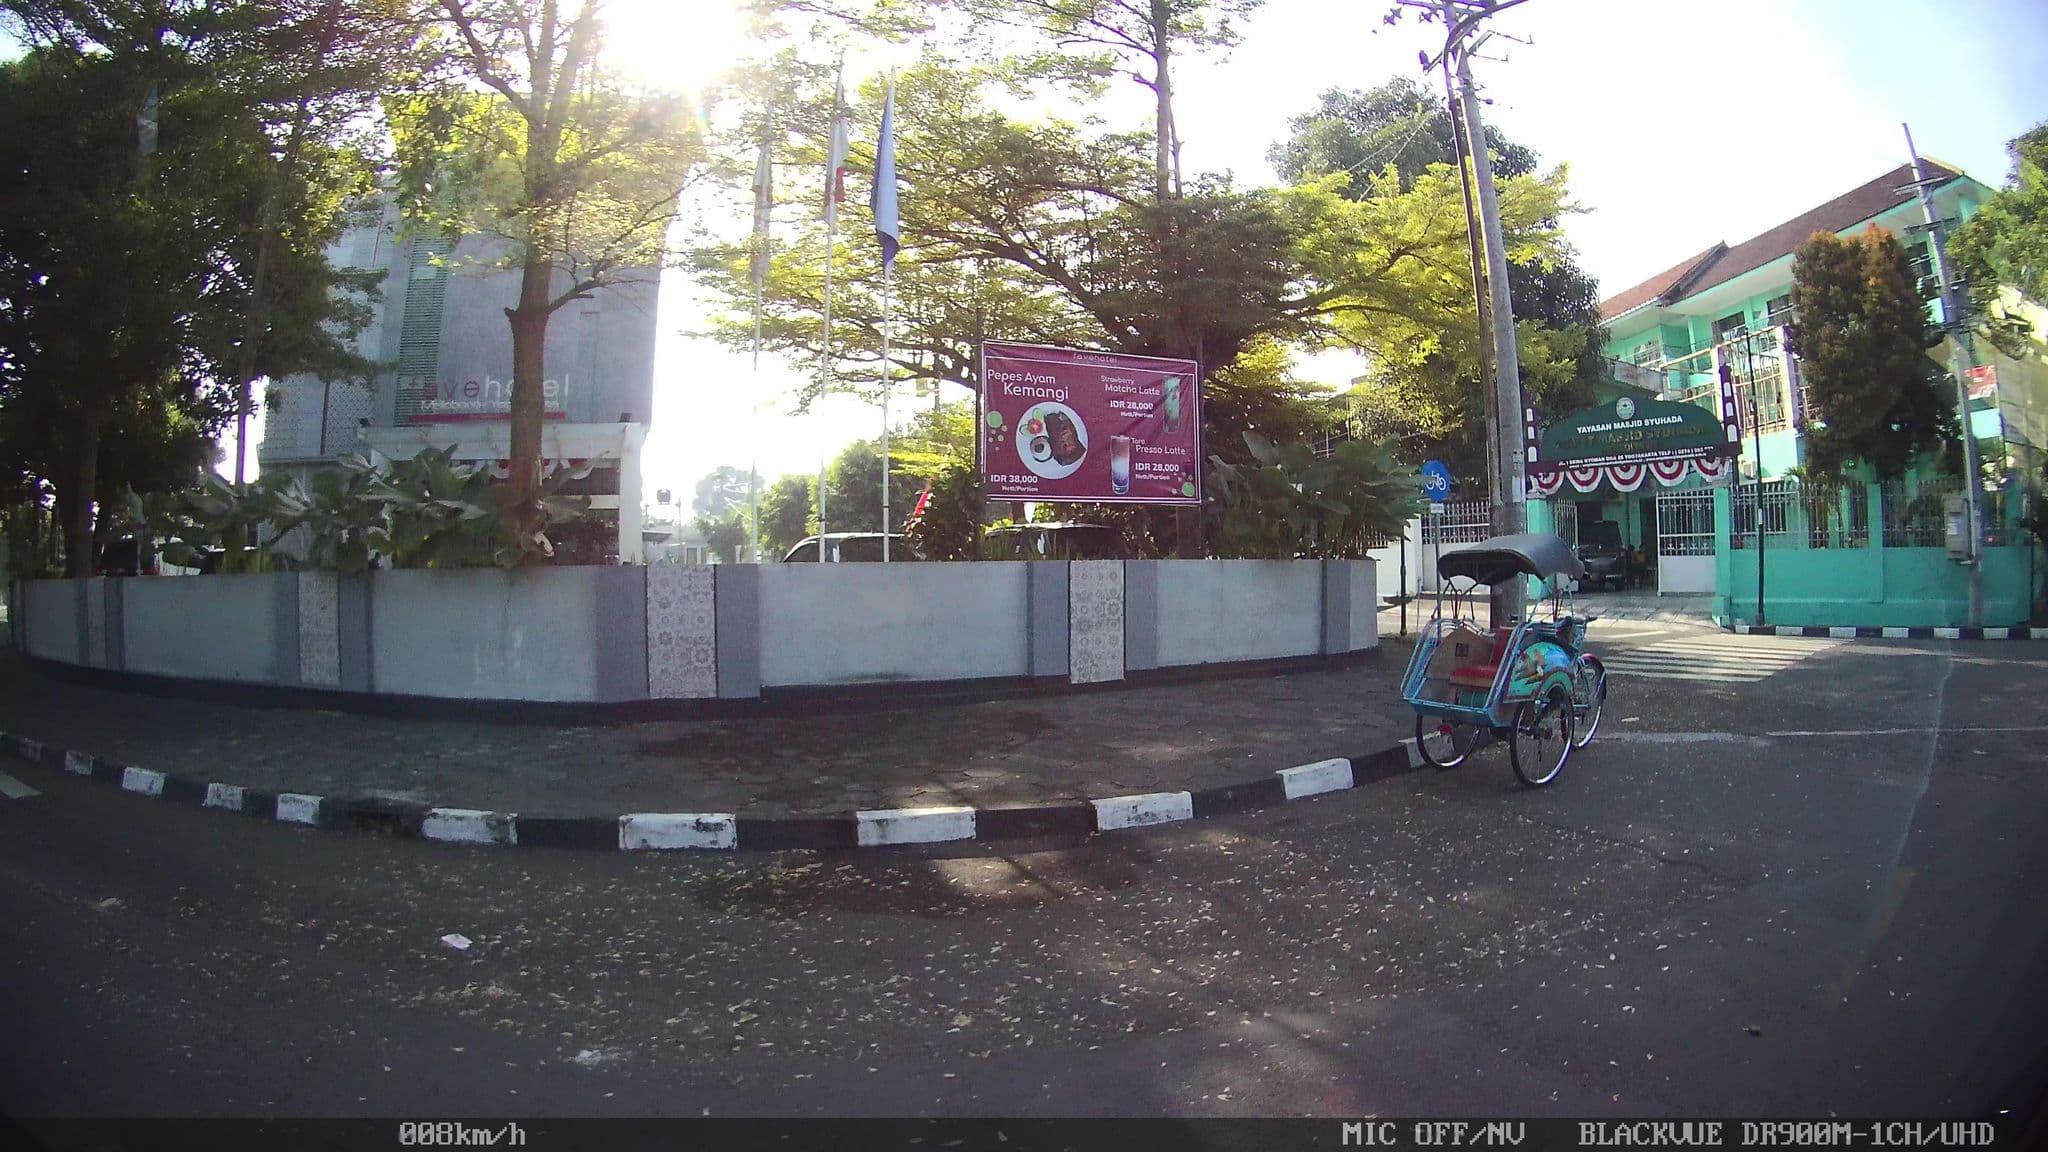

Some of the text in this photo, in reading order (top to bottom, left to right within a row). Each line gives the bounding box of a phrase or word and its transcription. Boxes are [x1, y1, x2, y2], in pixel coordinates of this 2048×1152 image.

[988, 369, 1056, 384] Pepes Ayam
[1004, 382, 1069, 402] Kemangi
[1105, 383, 1160, 396] Matcha Latte
[1110, 400, 1154, 410] IDR 28,000
[1577, 415, 1683, 435] YAYASAN MASJID SYUHADA
[1136, 445, 1186, 455] Presso Latte
[1135, 462, 1180, 472] IDR 28,000
[990, 474, 1038, 484] IDR 38,000
